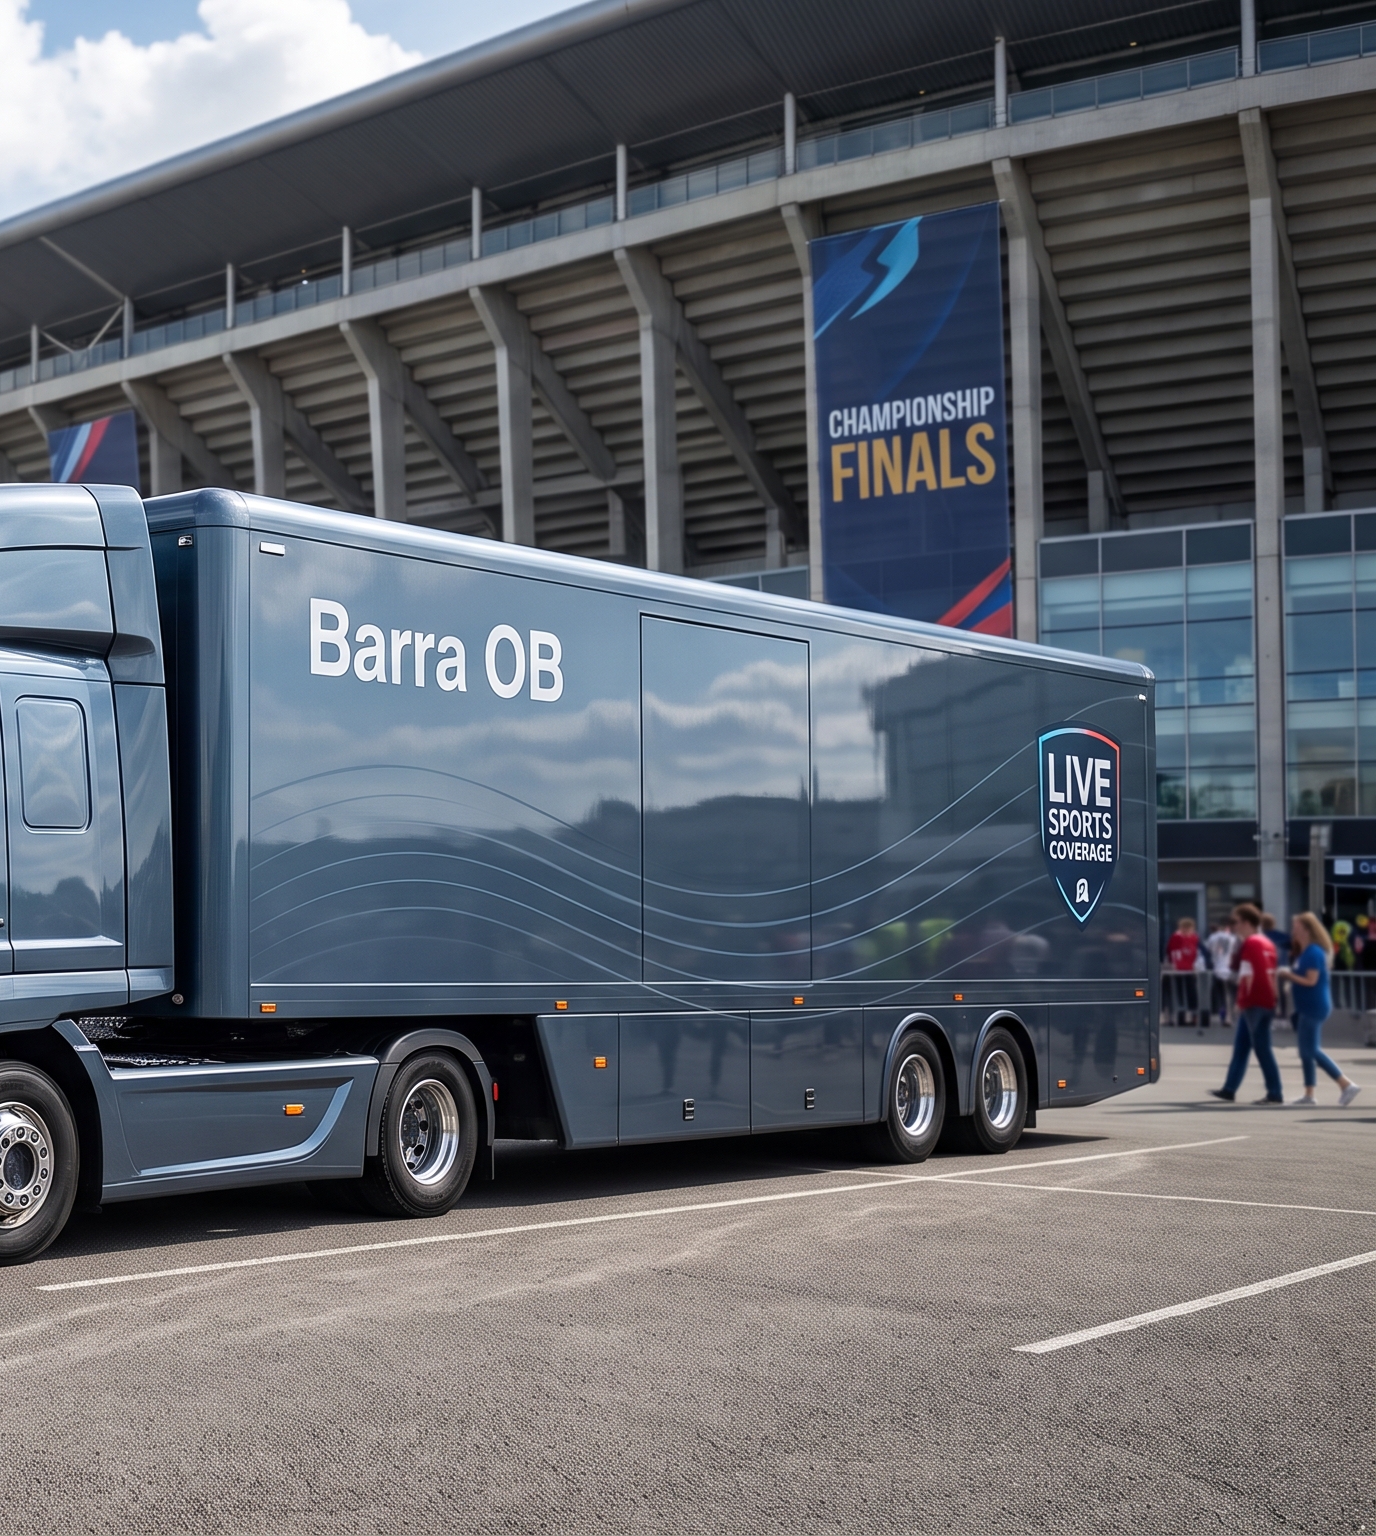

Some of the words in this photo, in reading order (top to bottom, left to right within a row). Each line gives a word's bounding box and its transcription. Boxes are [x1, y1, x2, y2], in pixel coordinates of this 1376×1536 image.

[829, 386, 995, 438] CHAMPIONSHIP
[831, 422, 996, 502] FINALS
[310, 597, 467, 692] Barra
[485, 624, 564, 702] OB
[1048, 752, 1111, 807] LIVE
[1048, 808, 1112, 839] SPORTS
[1049, 840, 1113, 862] COVERAGE
